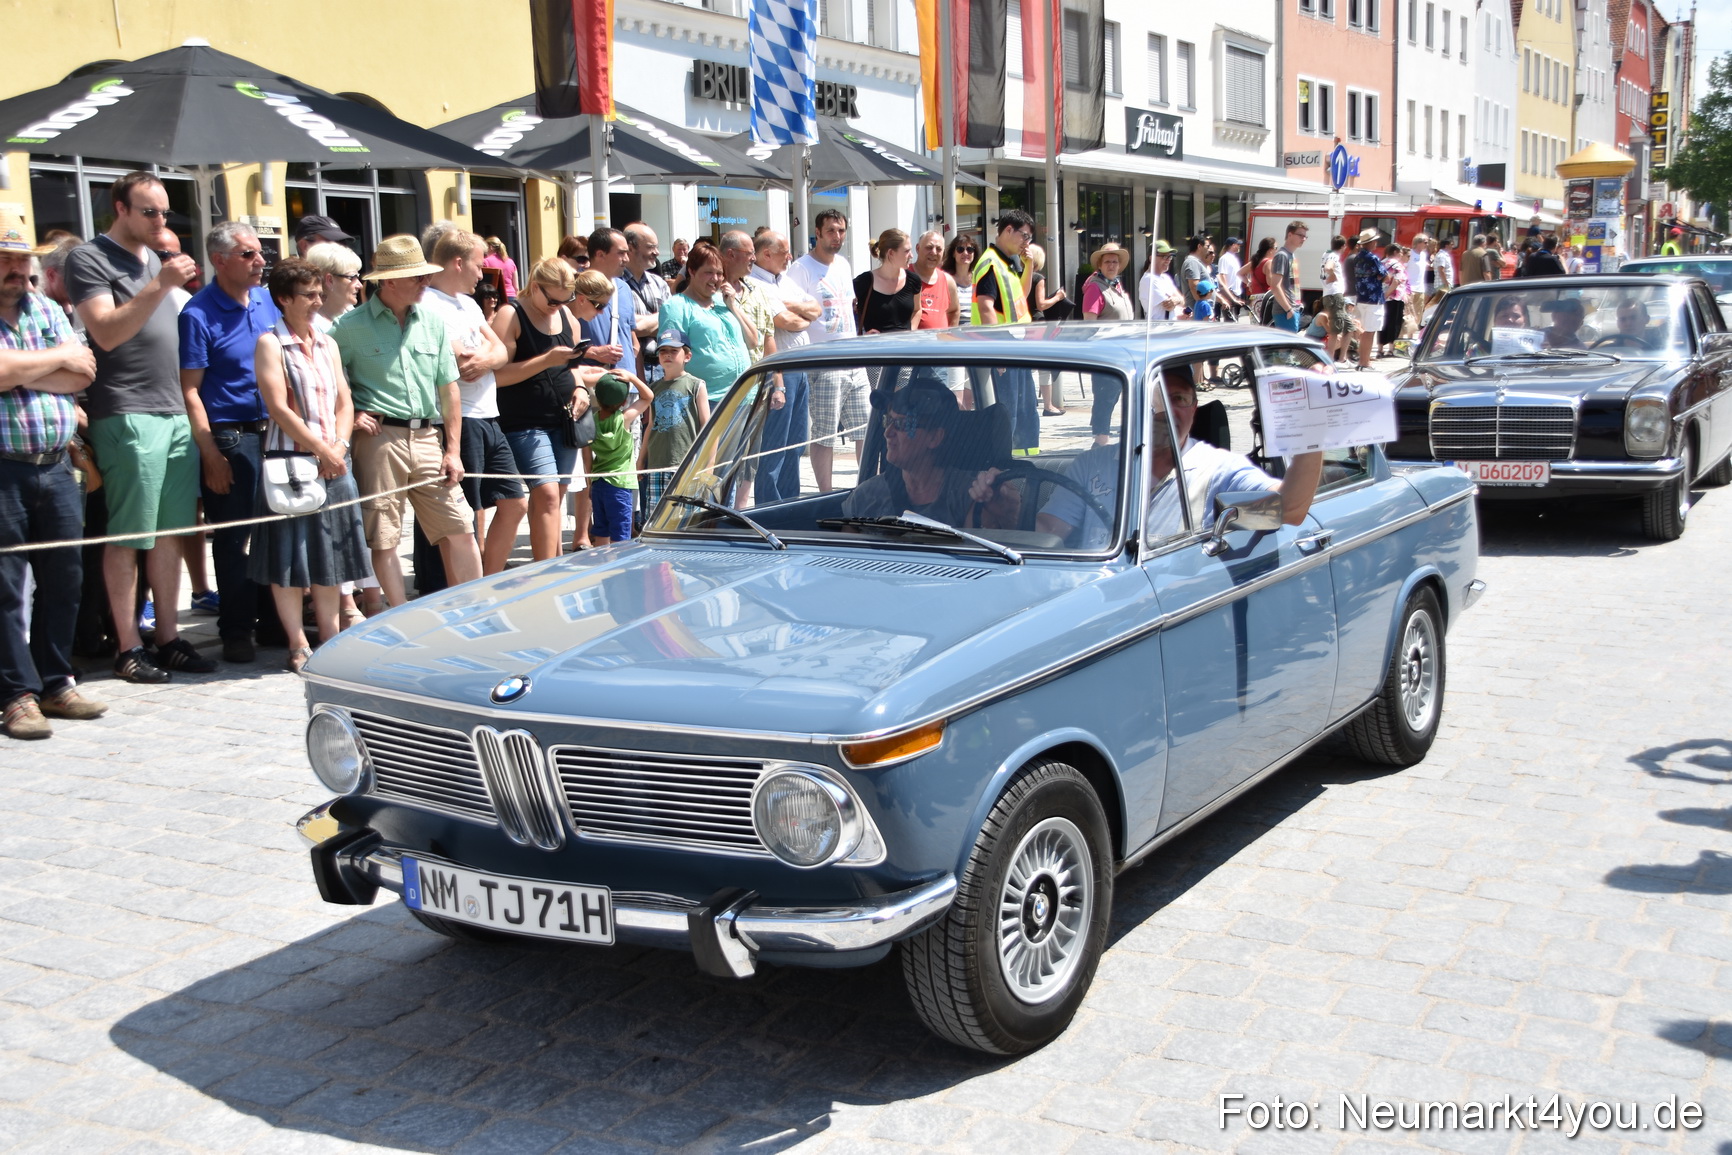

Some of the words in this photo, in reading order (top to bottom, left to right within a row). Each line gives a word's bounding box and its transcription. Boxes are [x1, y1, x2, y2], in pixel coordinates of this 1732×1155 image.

[693, 58, 750, 104] BRIL
[1132, 113, 1183, 156] frühauf
[1651, 93, 1668, 162] HOTE
[543, 195, 556, 211] 24
[1321, 379, 1364, 400] 199
[1479, 463, 1544, 481] 060209
[409, 887, 416, 900] D
[419, 865, 460, 913] NM
